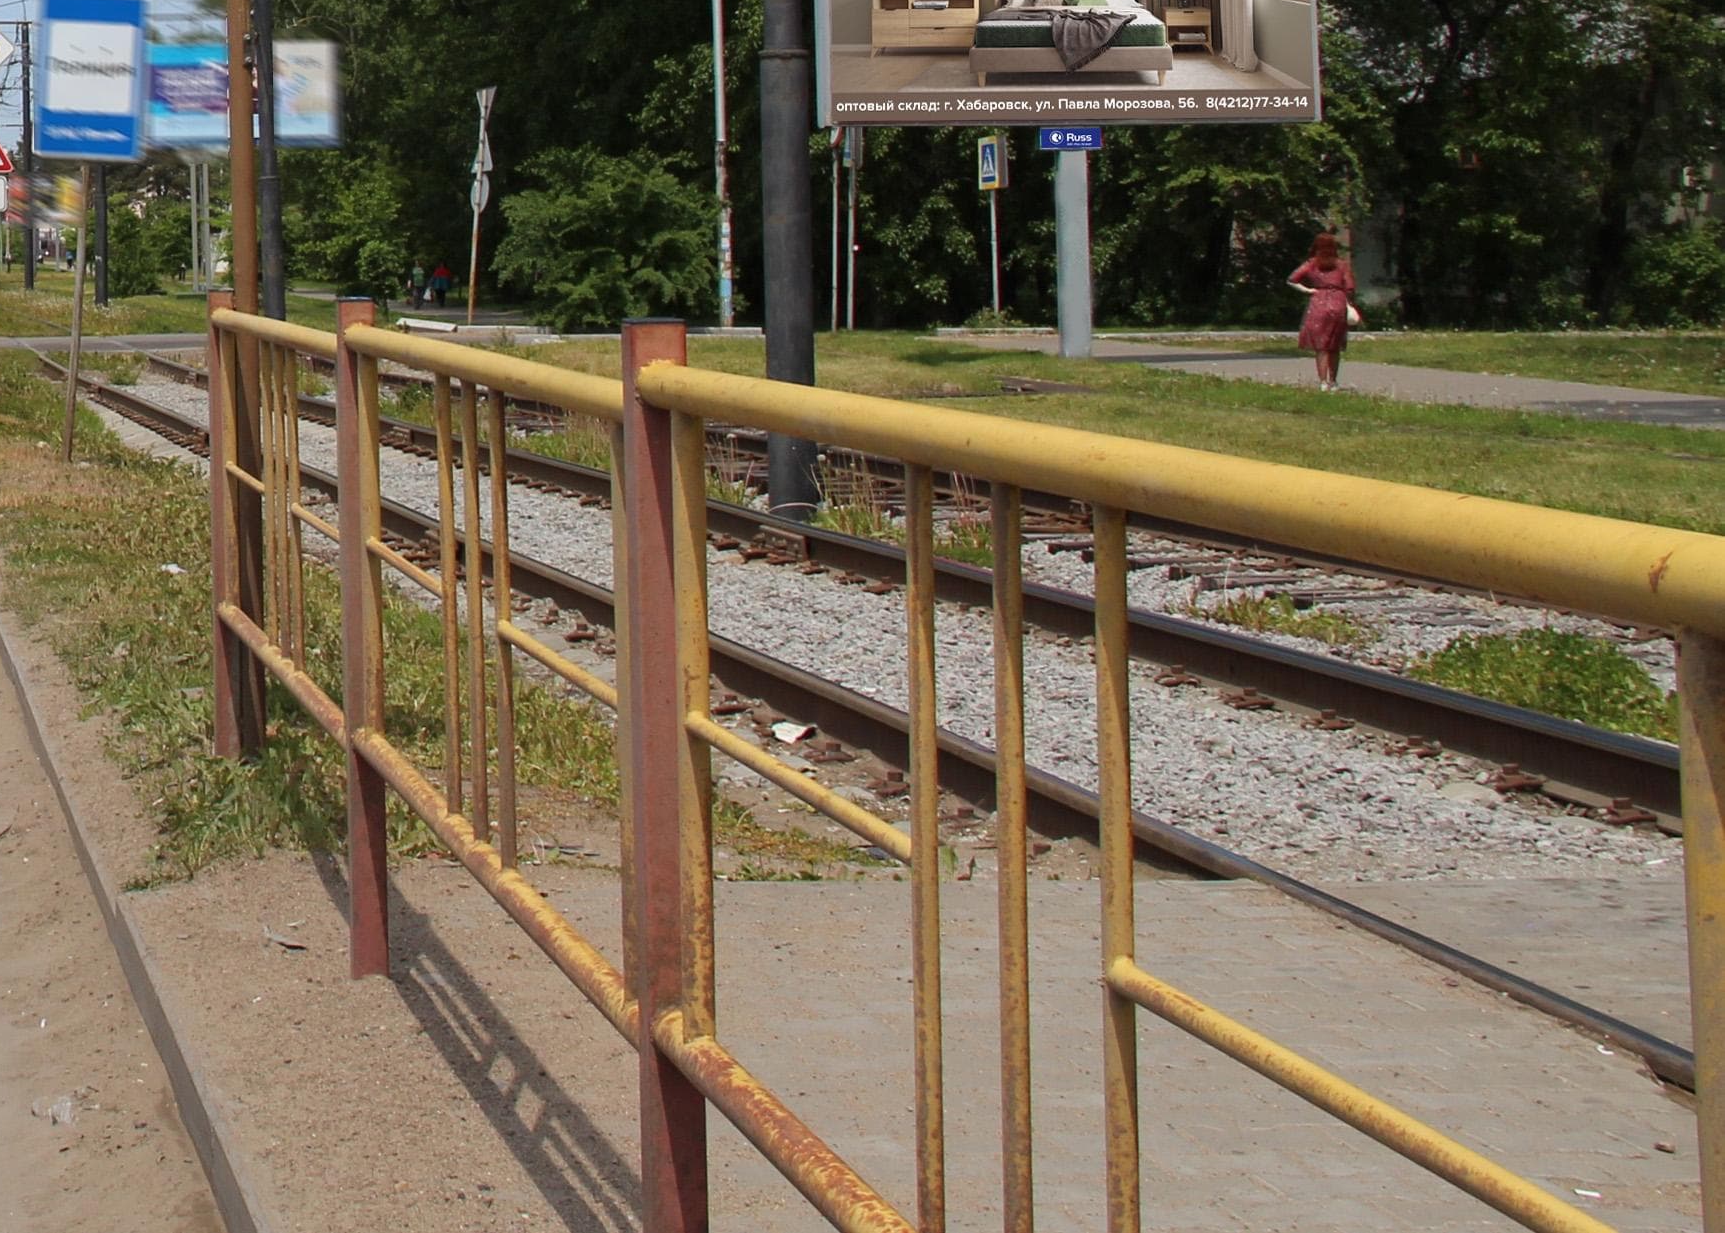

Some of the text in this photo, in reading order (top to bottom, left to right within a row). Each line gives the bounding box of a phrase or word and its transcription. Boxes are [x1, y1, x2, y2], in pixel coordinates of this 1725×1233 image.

[836, 97, 1308, 113] оптовый склад: г. Хабаровск, ул. Павла Морозова, 56. 8(4212)77-34-14
[1066, 133, 1092, 142] Russ
